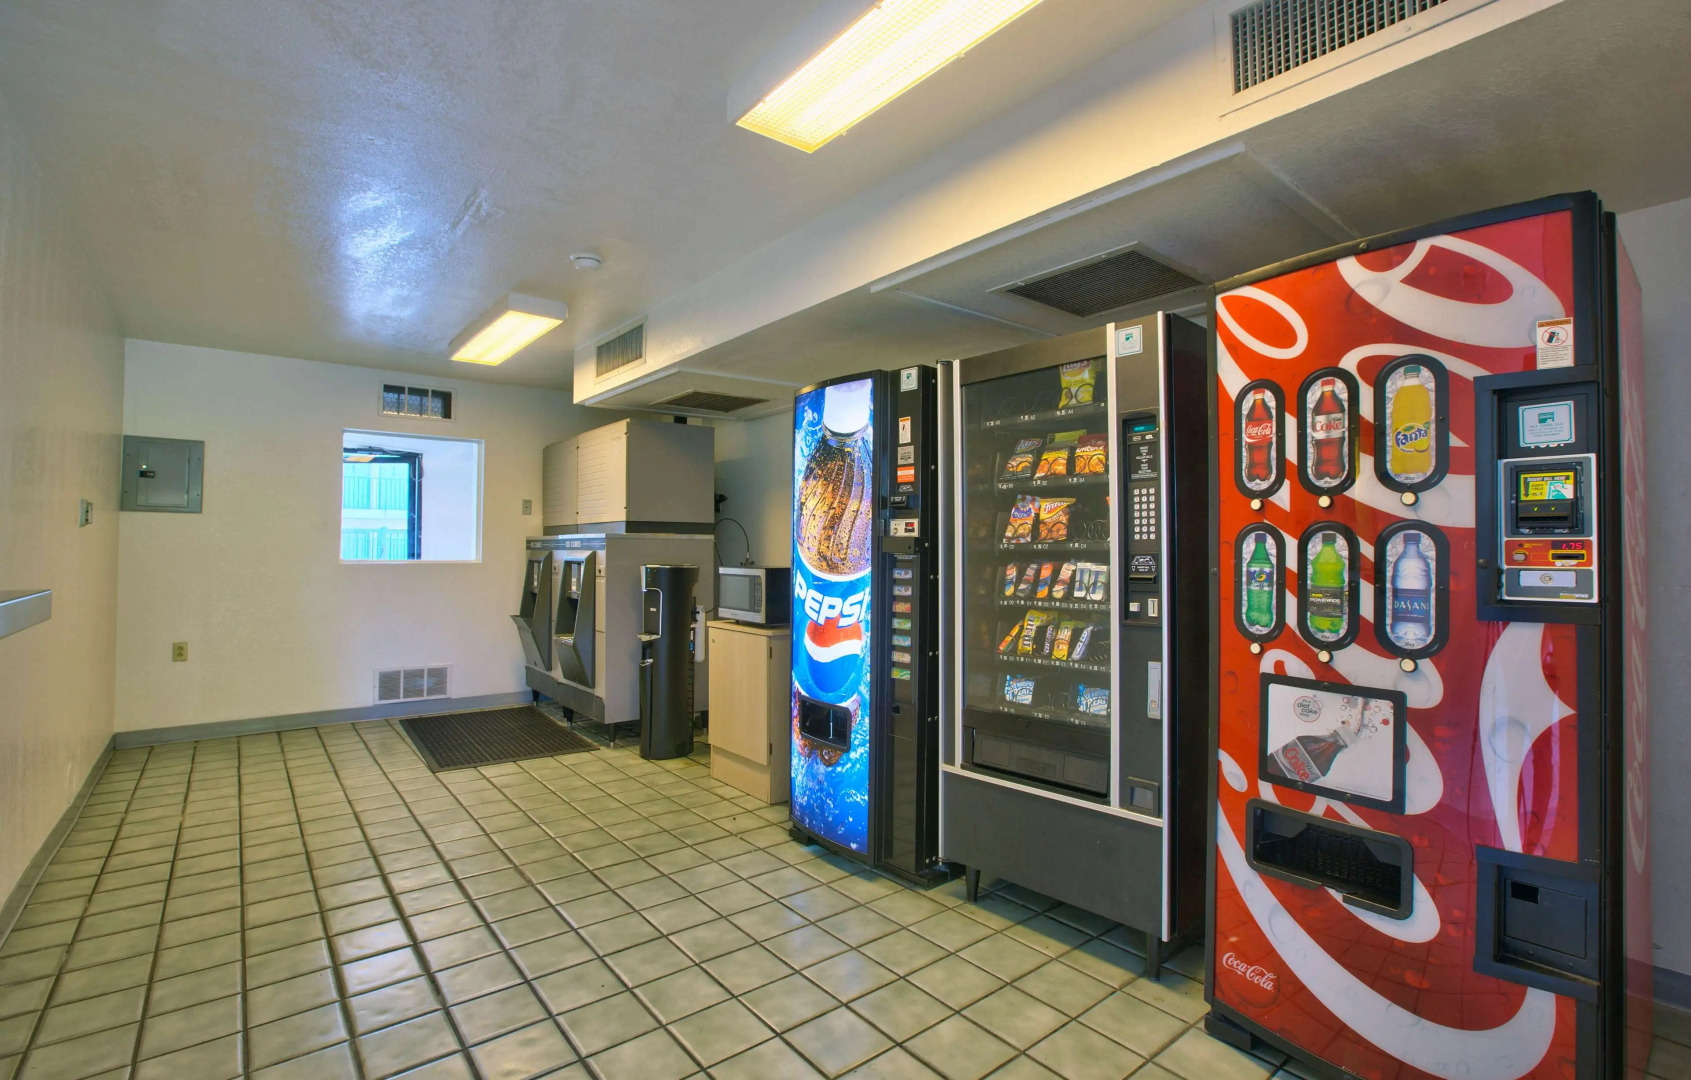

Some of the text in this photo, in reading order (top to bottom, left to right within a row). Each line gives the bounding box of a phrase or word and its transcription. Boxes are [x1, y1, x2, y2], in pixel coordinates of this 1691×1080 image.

[1246, 422, 1272, 436] Coca-Cola
[1314, 420, 1342, 432] Coke
[795, 569, 869, 627] PEPSI
[1394, 600, 1429, 610] DASANI
[1284, 746, 1310, 781] Coke
[1222, 952, 1277, 992] Coca-Cola
